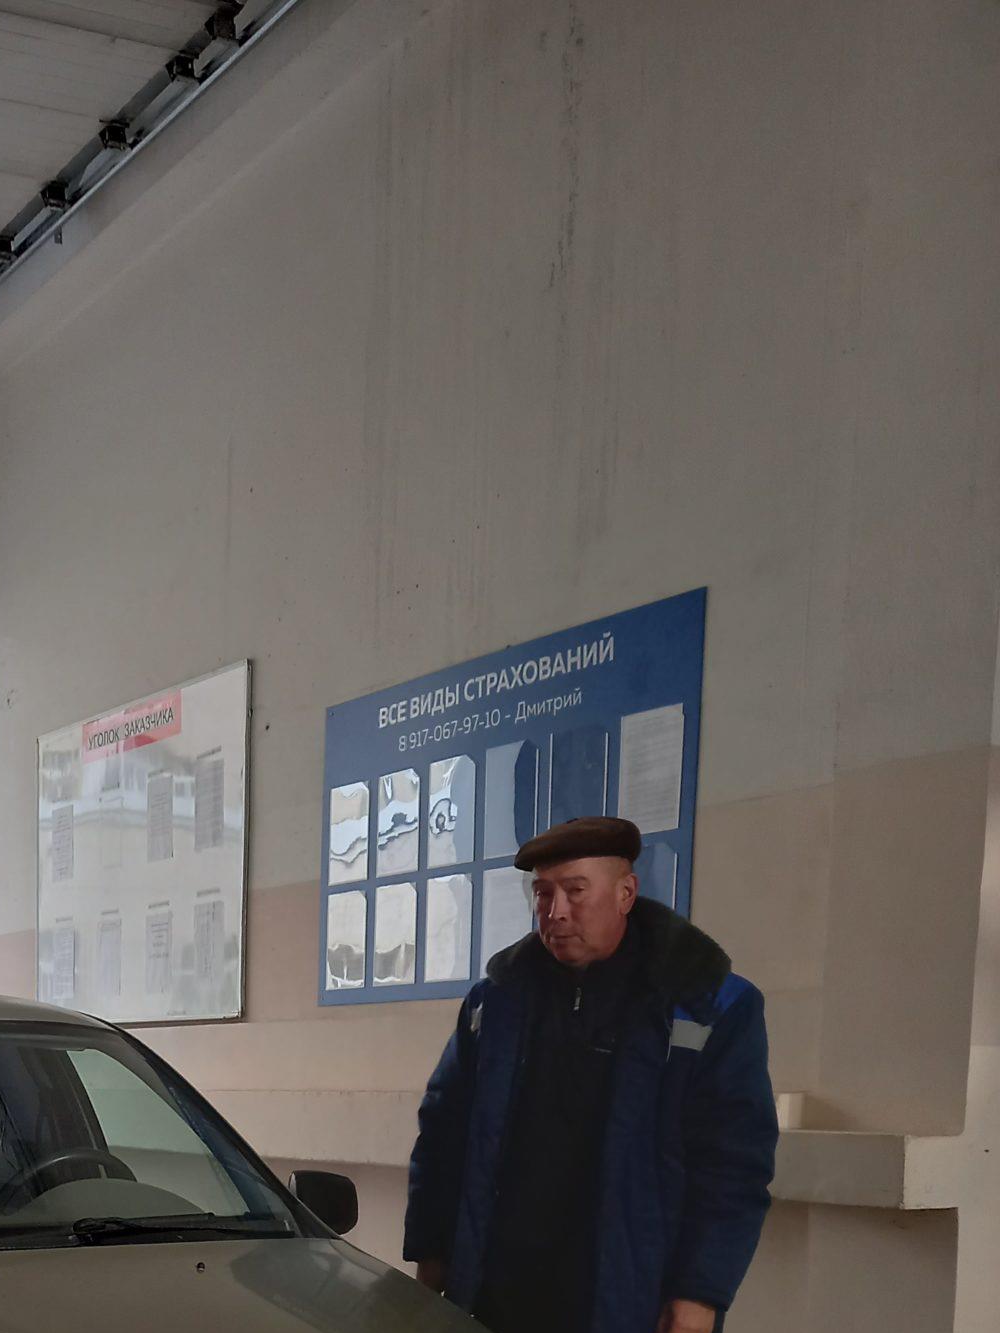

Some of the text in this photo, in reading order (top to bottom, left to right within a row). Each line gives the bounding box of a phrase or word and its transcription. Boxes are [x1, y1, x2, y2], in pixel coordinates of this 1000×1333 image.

[379, 631, 615, 729] ВСЕ ВИДЫ СТРАХОВАНИЙ
[88, 706, 174, 751] УГОЛОК ЗАКАЗЧИКА
[398, 735, 408, 752] 8
[409, 708, 501, 749] 917-067-97-10
[514, 687, 583, 723] Дмитрий
